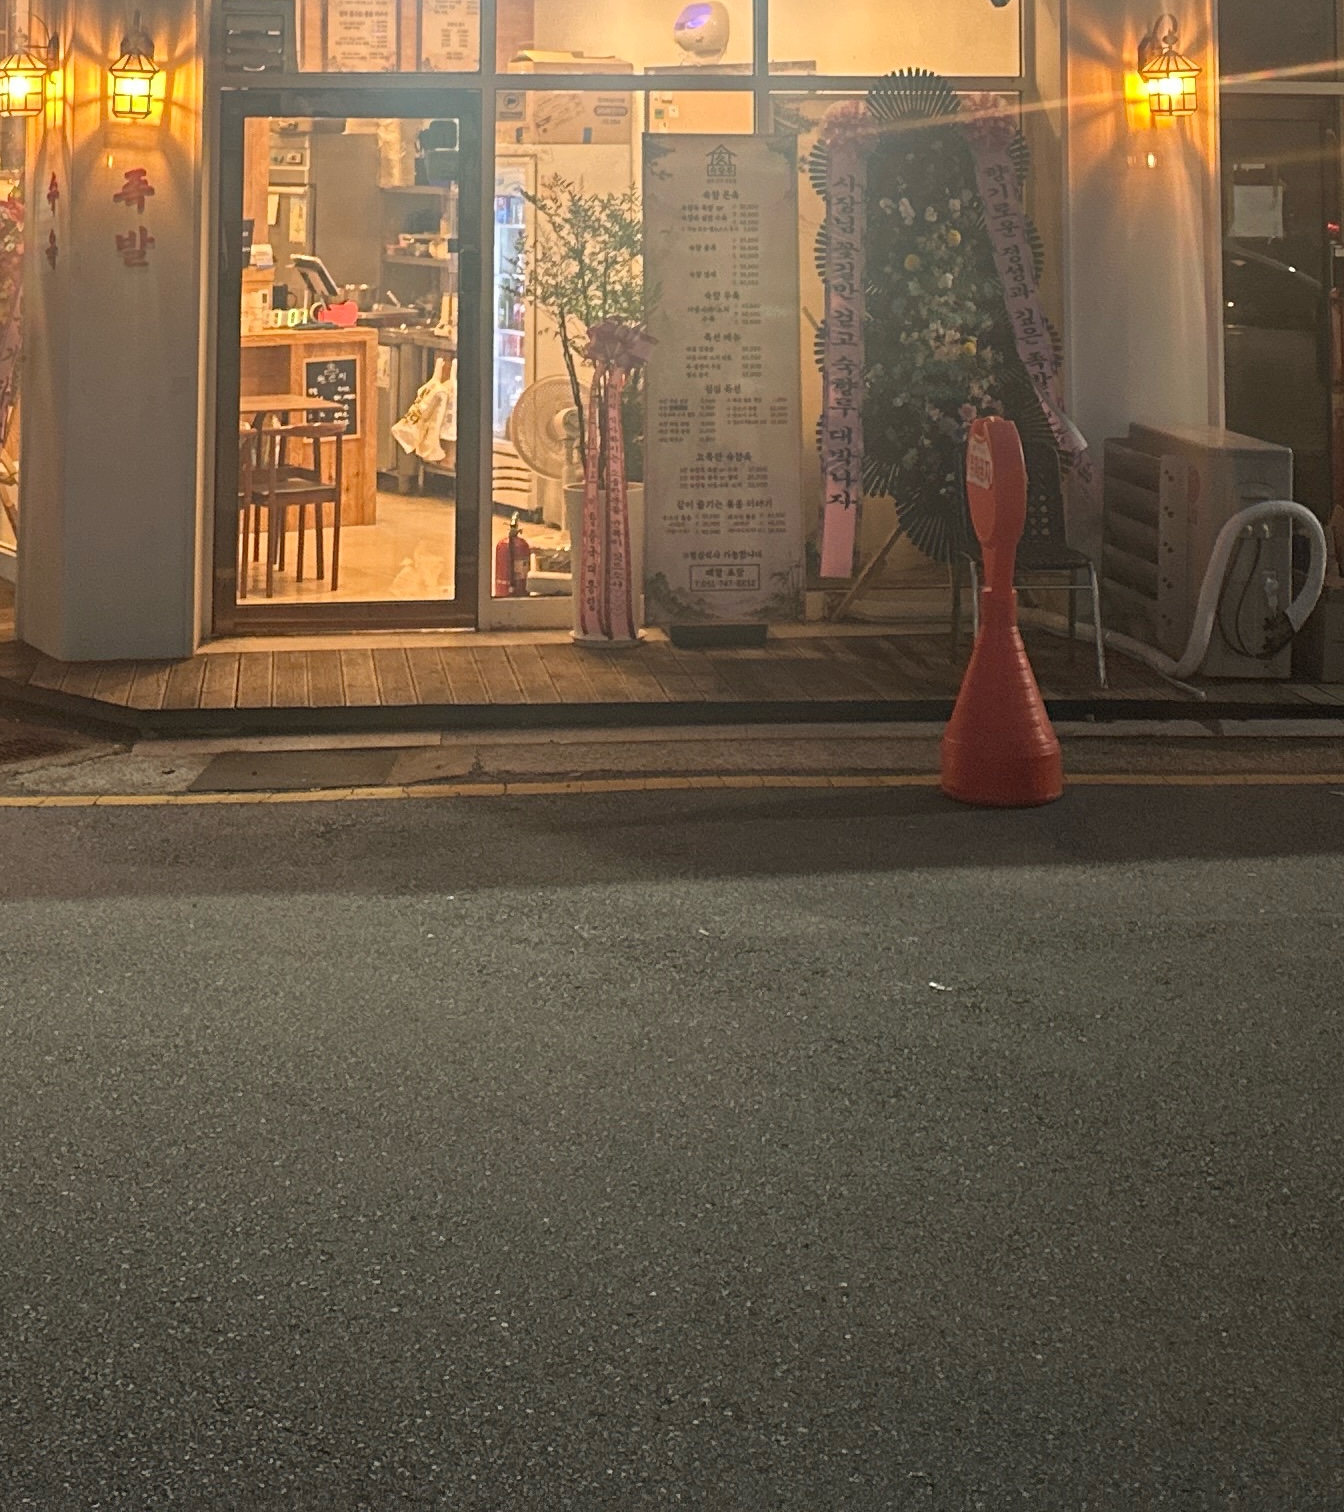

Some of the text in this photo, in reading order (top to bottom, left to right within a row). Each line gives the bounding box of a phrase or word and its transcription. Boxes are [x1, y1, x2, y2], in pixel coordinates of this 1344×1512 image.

[983, 164, 1021, 239] 향기로운
[828, 355, 859, 419] 숙향루
[826, 426, 858, 511] 대박나자
